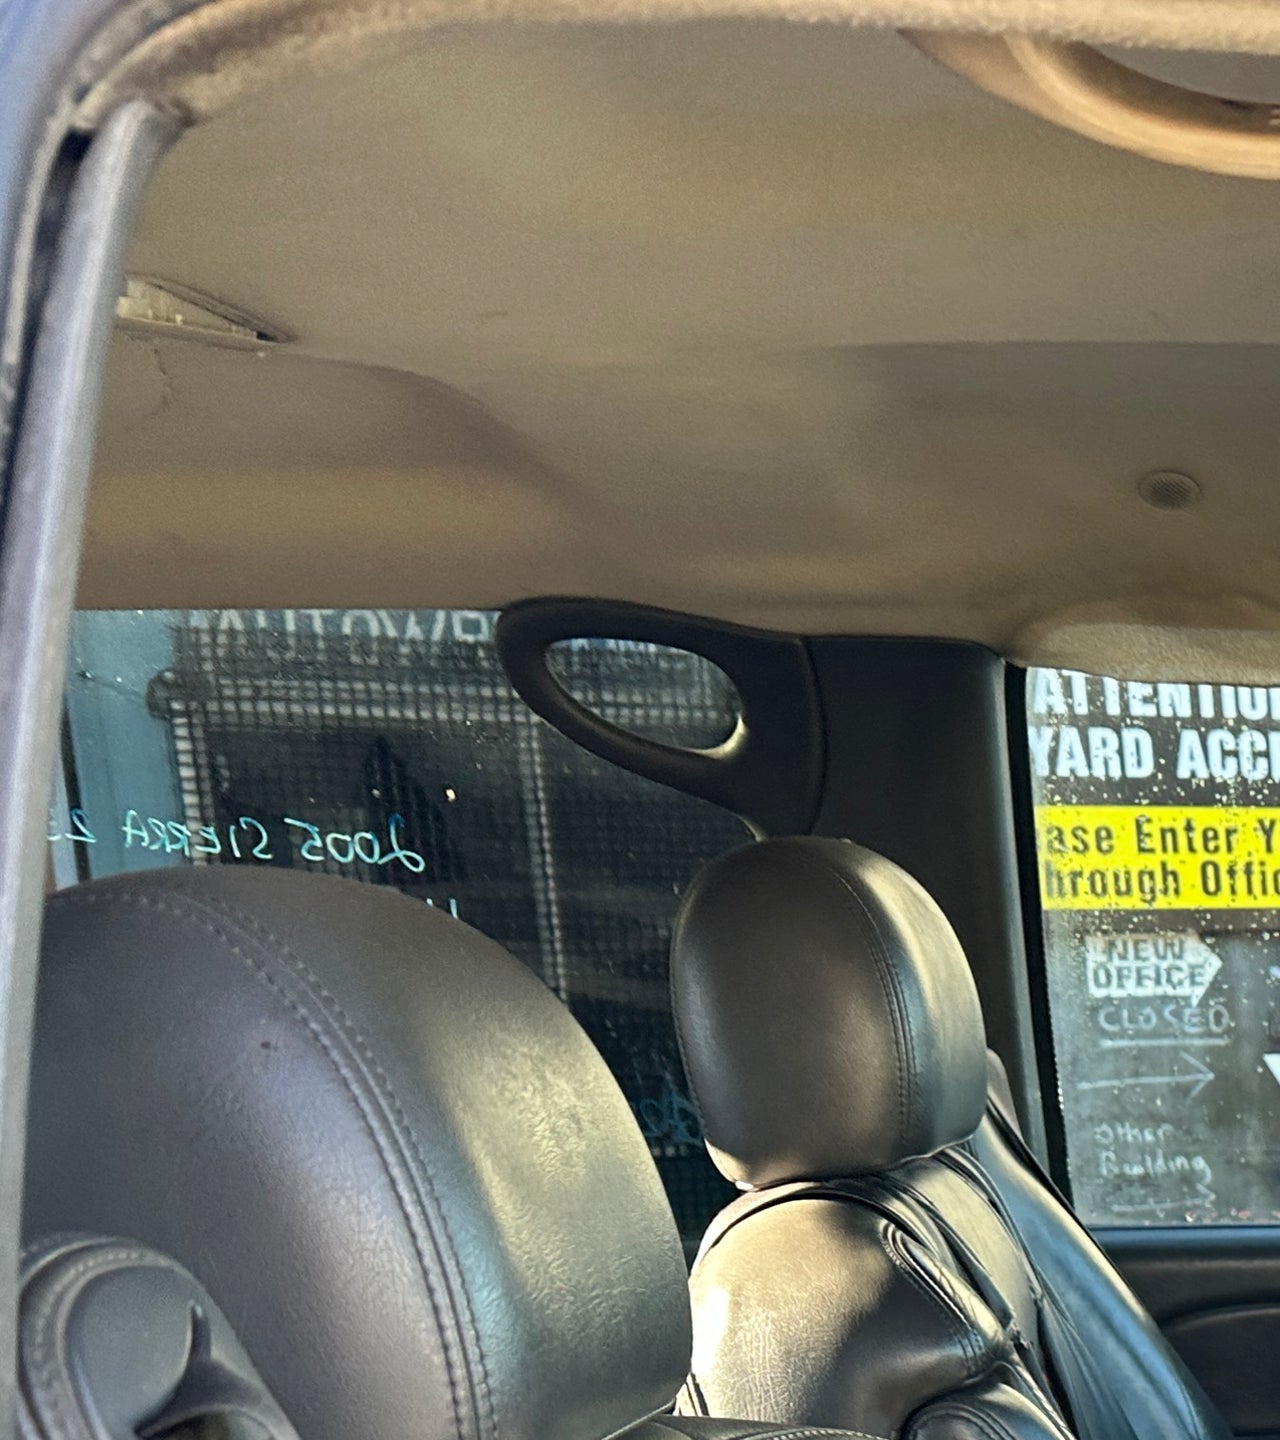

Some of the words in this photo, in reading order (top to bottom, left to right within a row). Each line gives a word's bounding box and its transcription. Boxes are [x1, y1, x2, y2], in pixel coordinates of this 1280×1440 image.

[1135, 818, 1238, 855] Enter
[1045, 860, 1181, 904] hrough
[1107, 938, 1186, 962] NEW
[1093, 963, 1206, 990] OFFICE
[1097, 1004, 1231, 1035] CLOSED
